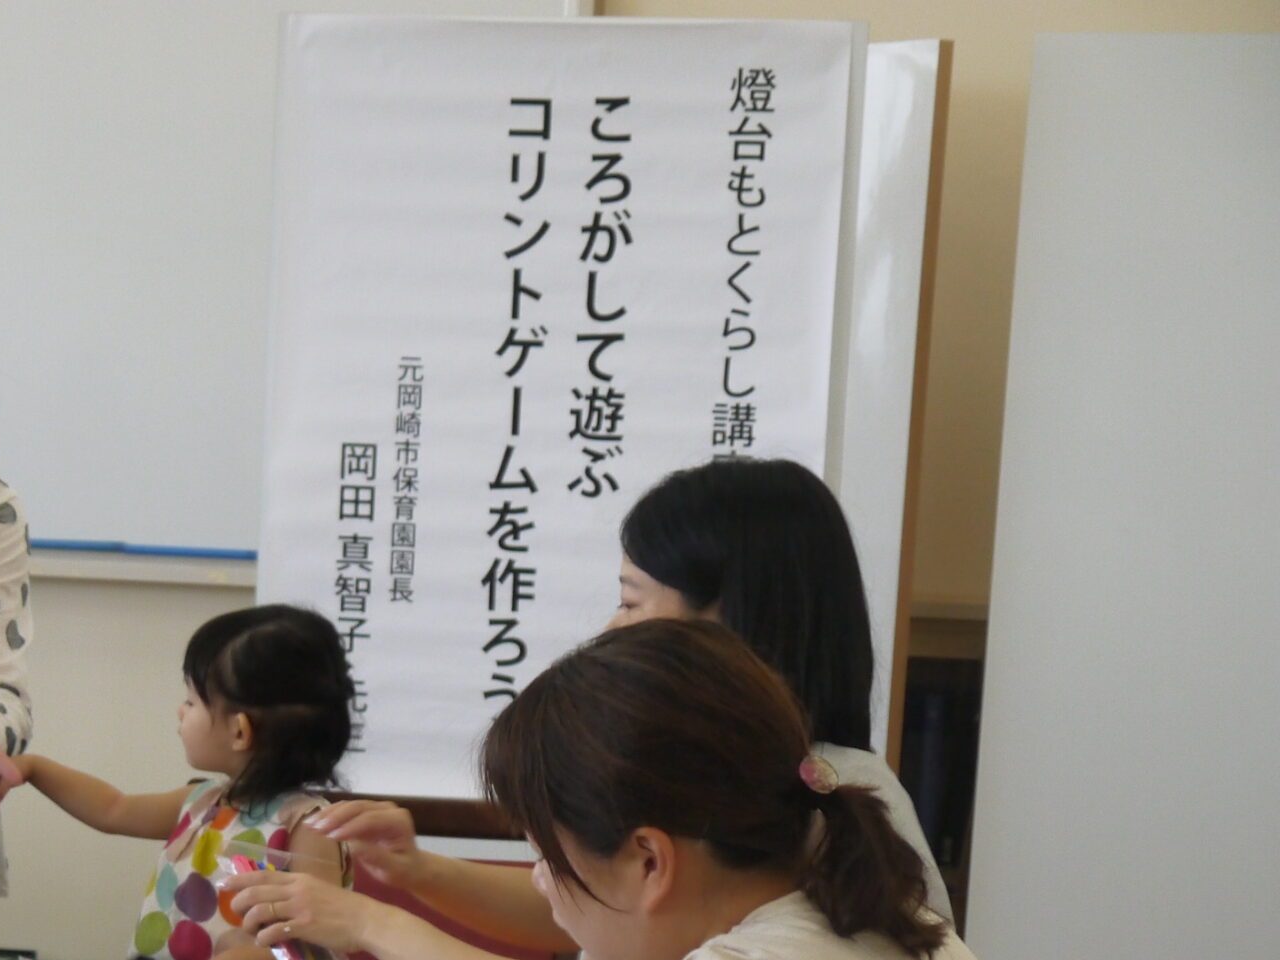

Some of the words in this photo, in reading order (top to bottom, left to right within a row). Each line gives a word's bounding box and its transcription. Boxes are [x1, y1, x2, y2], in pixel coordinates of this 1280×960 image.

[568, 96, 633, 499] ころがして遊ぶ
[711, 66, 777, 460] 燈台もとくらし講
[388, 356, 423, 603] 元岡崎市保育園園長
